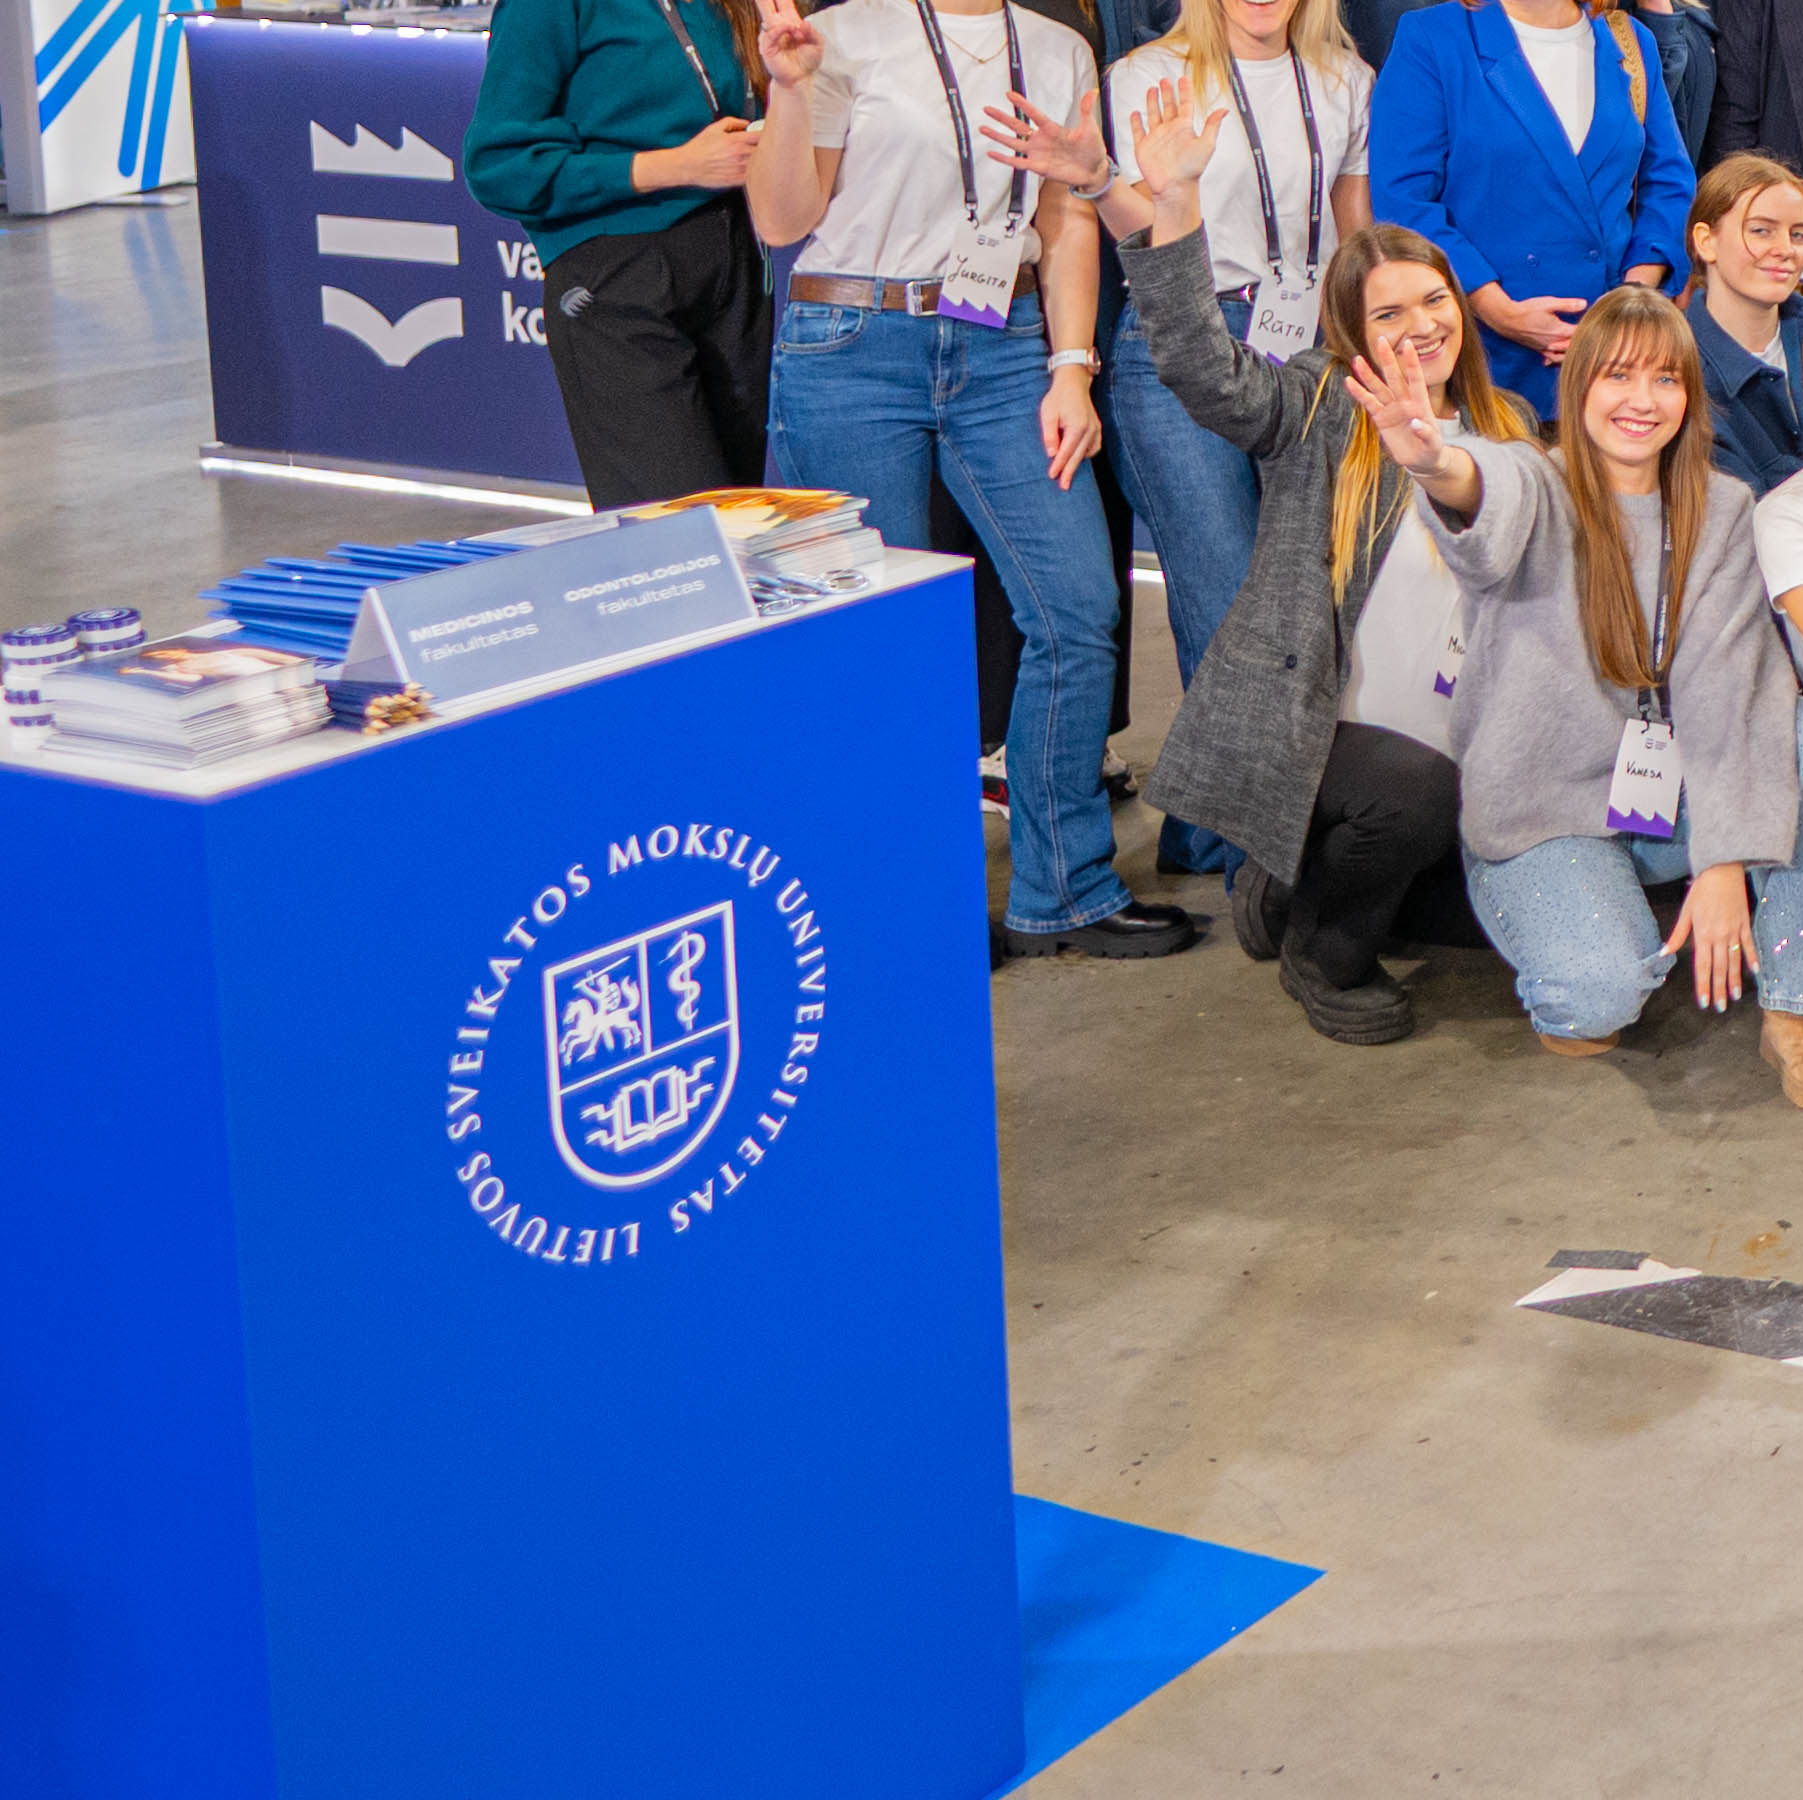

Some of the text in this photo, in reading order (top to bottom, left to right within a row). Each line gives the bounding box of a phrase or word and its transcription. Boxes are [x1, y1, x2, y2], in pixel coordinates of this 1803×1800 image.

[1257, 308, 1306, 340] RŪTA
[563, 553, 722, 603] ODONTOLOGIJOS
[596, 578, 706, 617] fakultetas
[408, 600, 535, 643] MEDICINOS
[419, 620, 540, 664] fakultetas
[1626, 759, 1664, 781] VANESA
[446, 822, 827, 1265] LIETUVOS SVEIKATOS MOKSLŲ UNIVERSITETAS
